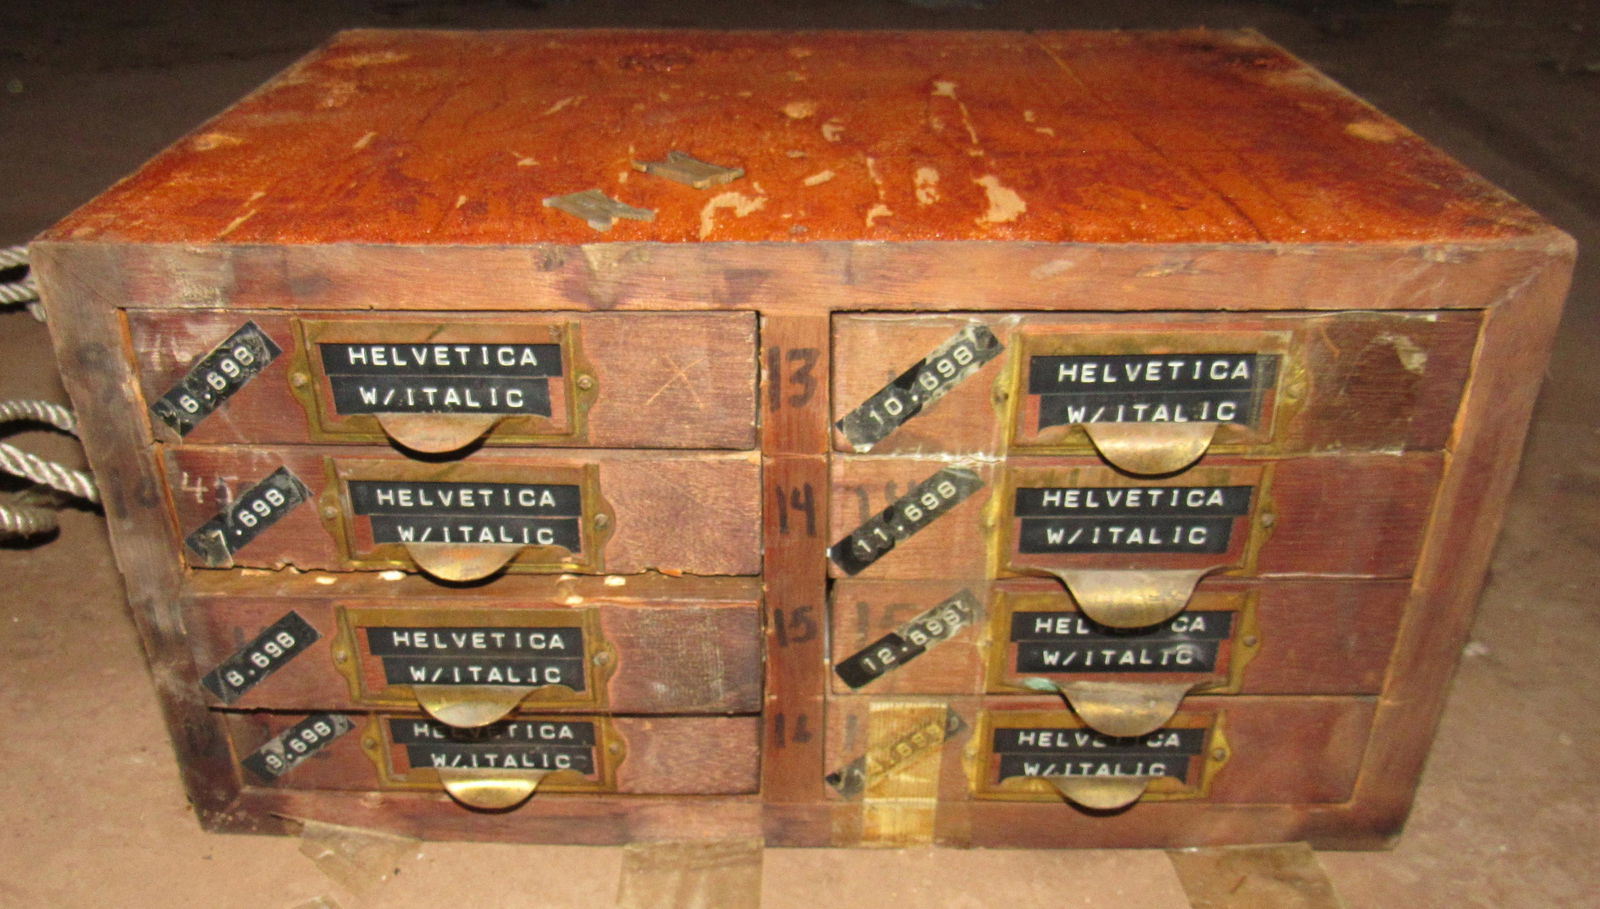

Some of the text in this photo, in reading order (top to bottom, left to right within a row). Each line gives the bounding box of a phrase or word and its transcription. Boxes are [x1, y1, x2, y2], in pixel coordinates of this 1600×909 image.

[348, 345, 538, 367] HELVETICA
[179, 346, 254, 413] 6.698
[767, 346, 821, 412] 13
[1058, 360, 1249, 382] HELVETICA
[870, 346, 973, 425] 10.698
[358, 386, 525, 408] W/ITALIC
[1067, 402, 1237, 424] W/ITALIC
[376, 488, 556, 508] HELVETICA
[776, 482, 816, 536] 14
[1042, 488, 1225, 508] HELVETICA
[208, 488, 285, 547] 7.698
[857, 481, 956, 552] 11.698
[397, 526, 555, 546] W/ITALIC
[1046, 526, 1208, 545] W/ITALIC
[774, 605, 818, 647] 15
[1035, 616, 1206, 634] HELCA
[393, 631, 565, 650] HELVETICA
[225, 631, 295, 687] 8.698
[1043, 649, 1194, 666] W/ITALIC
[410, 666, 562, 684] W/ITALIC
[265, 721, 331, 769] 9.698
[1018, 731, 1181, 748] HELVCA
[431, 753, 571, 769] W/ITALIC
[1023, 762, 1167, 777] W/ITALIC
